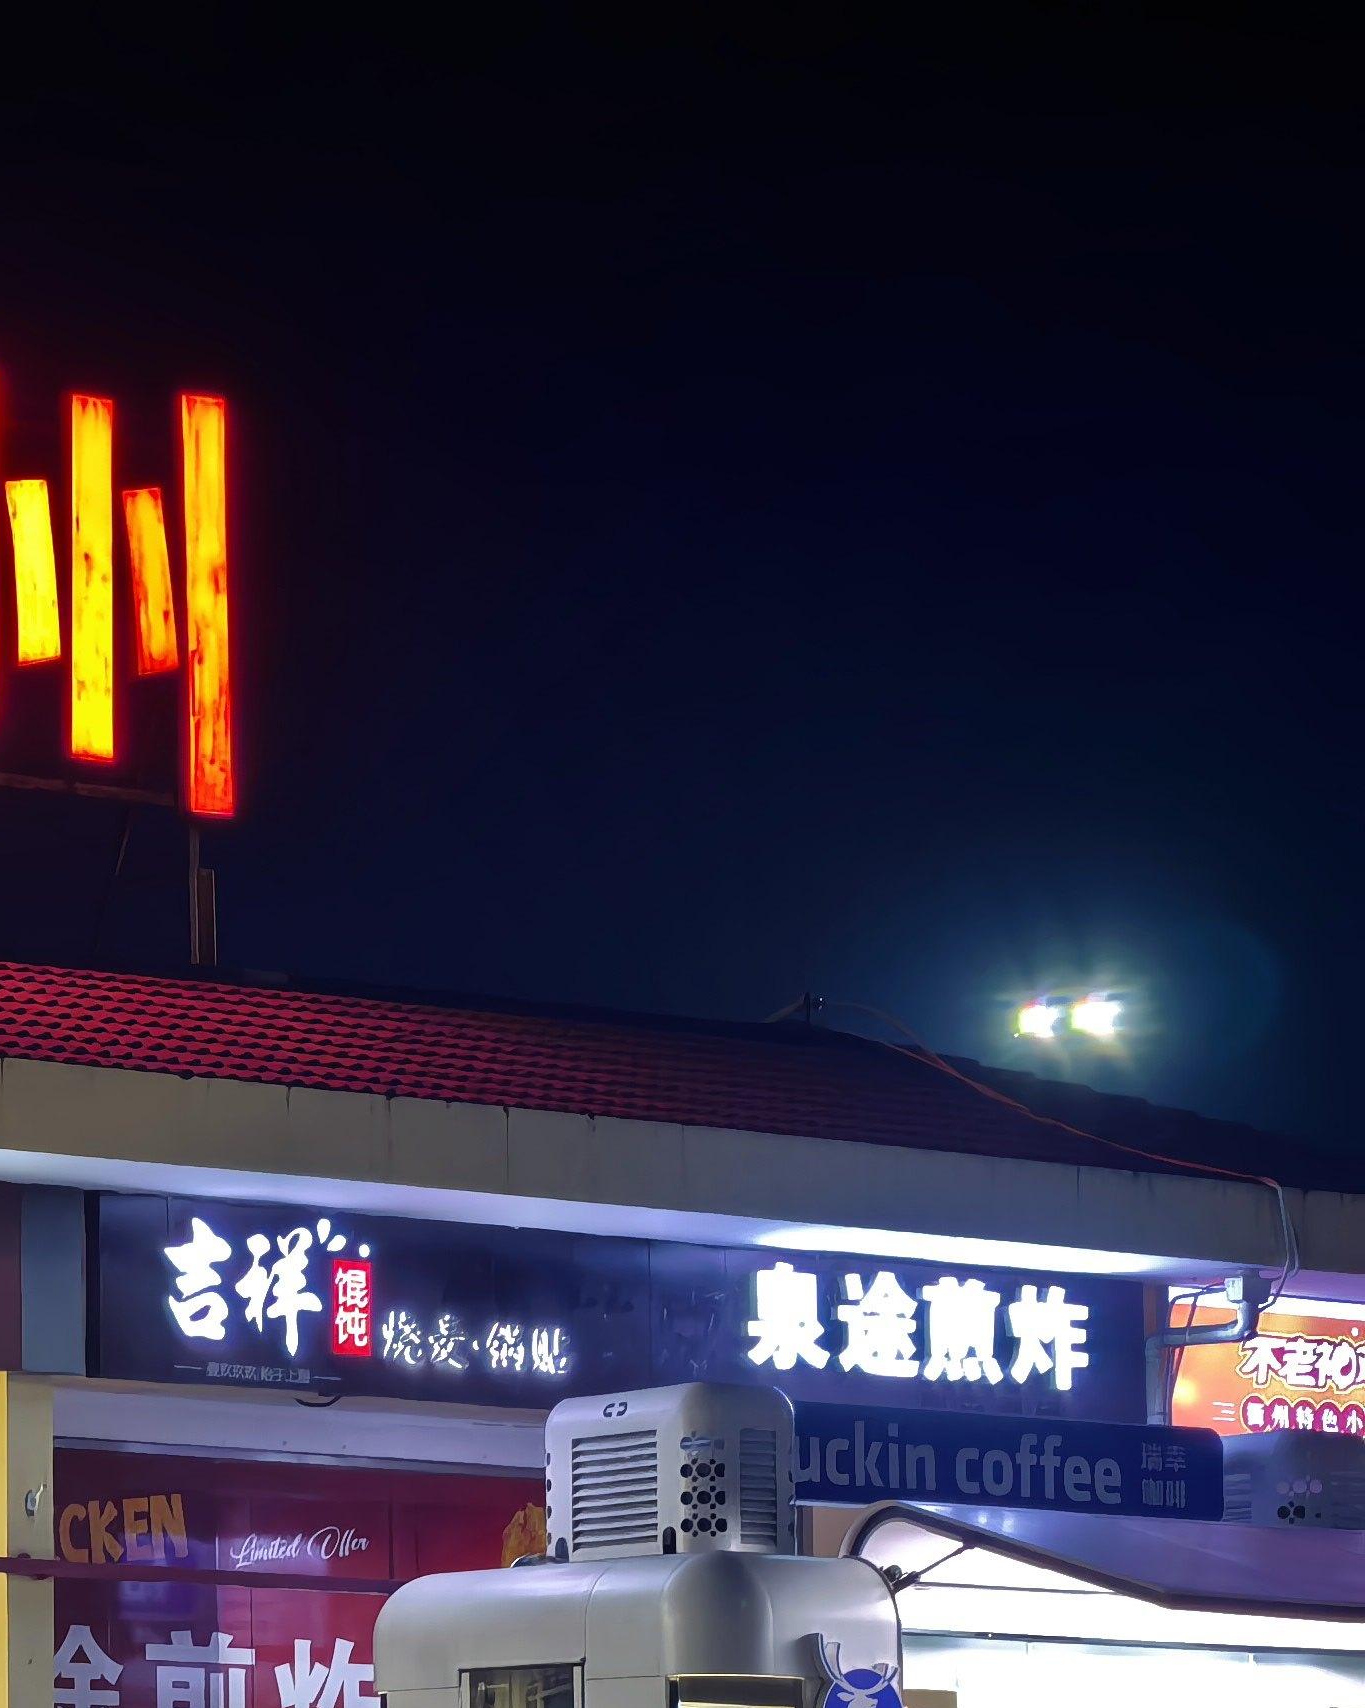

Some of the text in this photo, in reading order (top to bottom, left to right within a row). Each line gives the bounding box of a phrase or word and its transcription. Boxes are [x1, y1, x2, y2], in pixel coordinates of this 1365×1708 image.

[164, 1217, 323, 1357] 吉祥
[334, 1267, 370, 1347] 馄饨
[747, 1262, 1090, 1392] 泉途煎炸
[955, 1433, 1122, 1505] coffee
